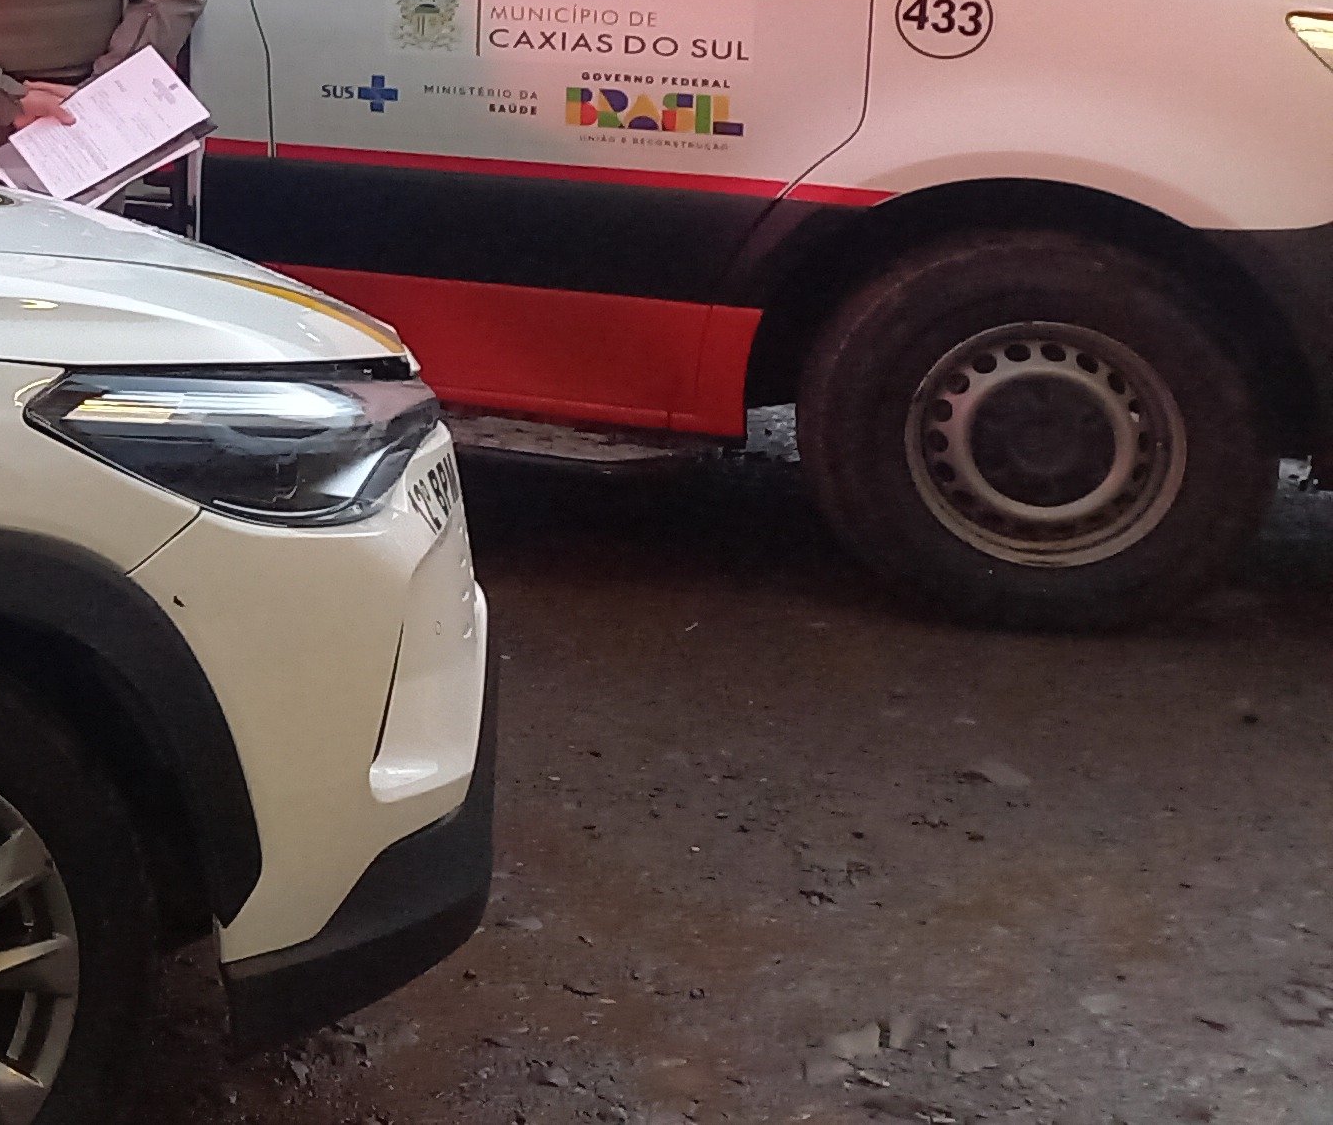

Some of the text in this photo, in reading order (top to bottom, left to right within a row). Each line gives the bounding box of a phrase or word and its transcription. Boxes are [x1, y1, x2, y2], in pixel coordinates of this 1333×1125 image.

[489, 3, 658, 28] MUNICÍPIO DE
[488, 29, 750, 62] CAXIAS DO SUL
[581, 71, 731, 89] GOVERNO FEDERAL
[321, 83, 355, 100] SUS
[423, 83, 539, 101] MINISTÉRIO DA
[488, 101, 539, 117] SAÚDE
[565, 86, 745, 137] BRASIL
